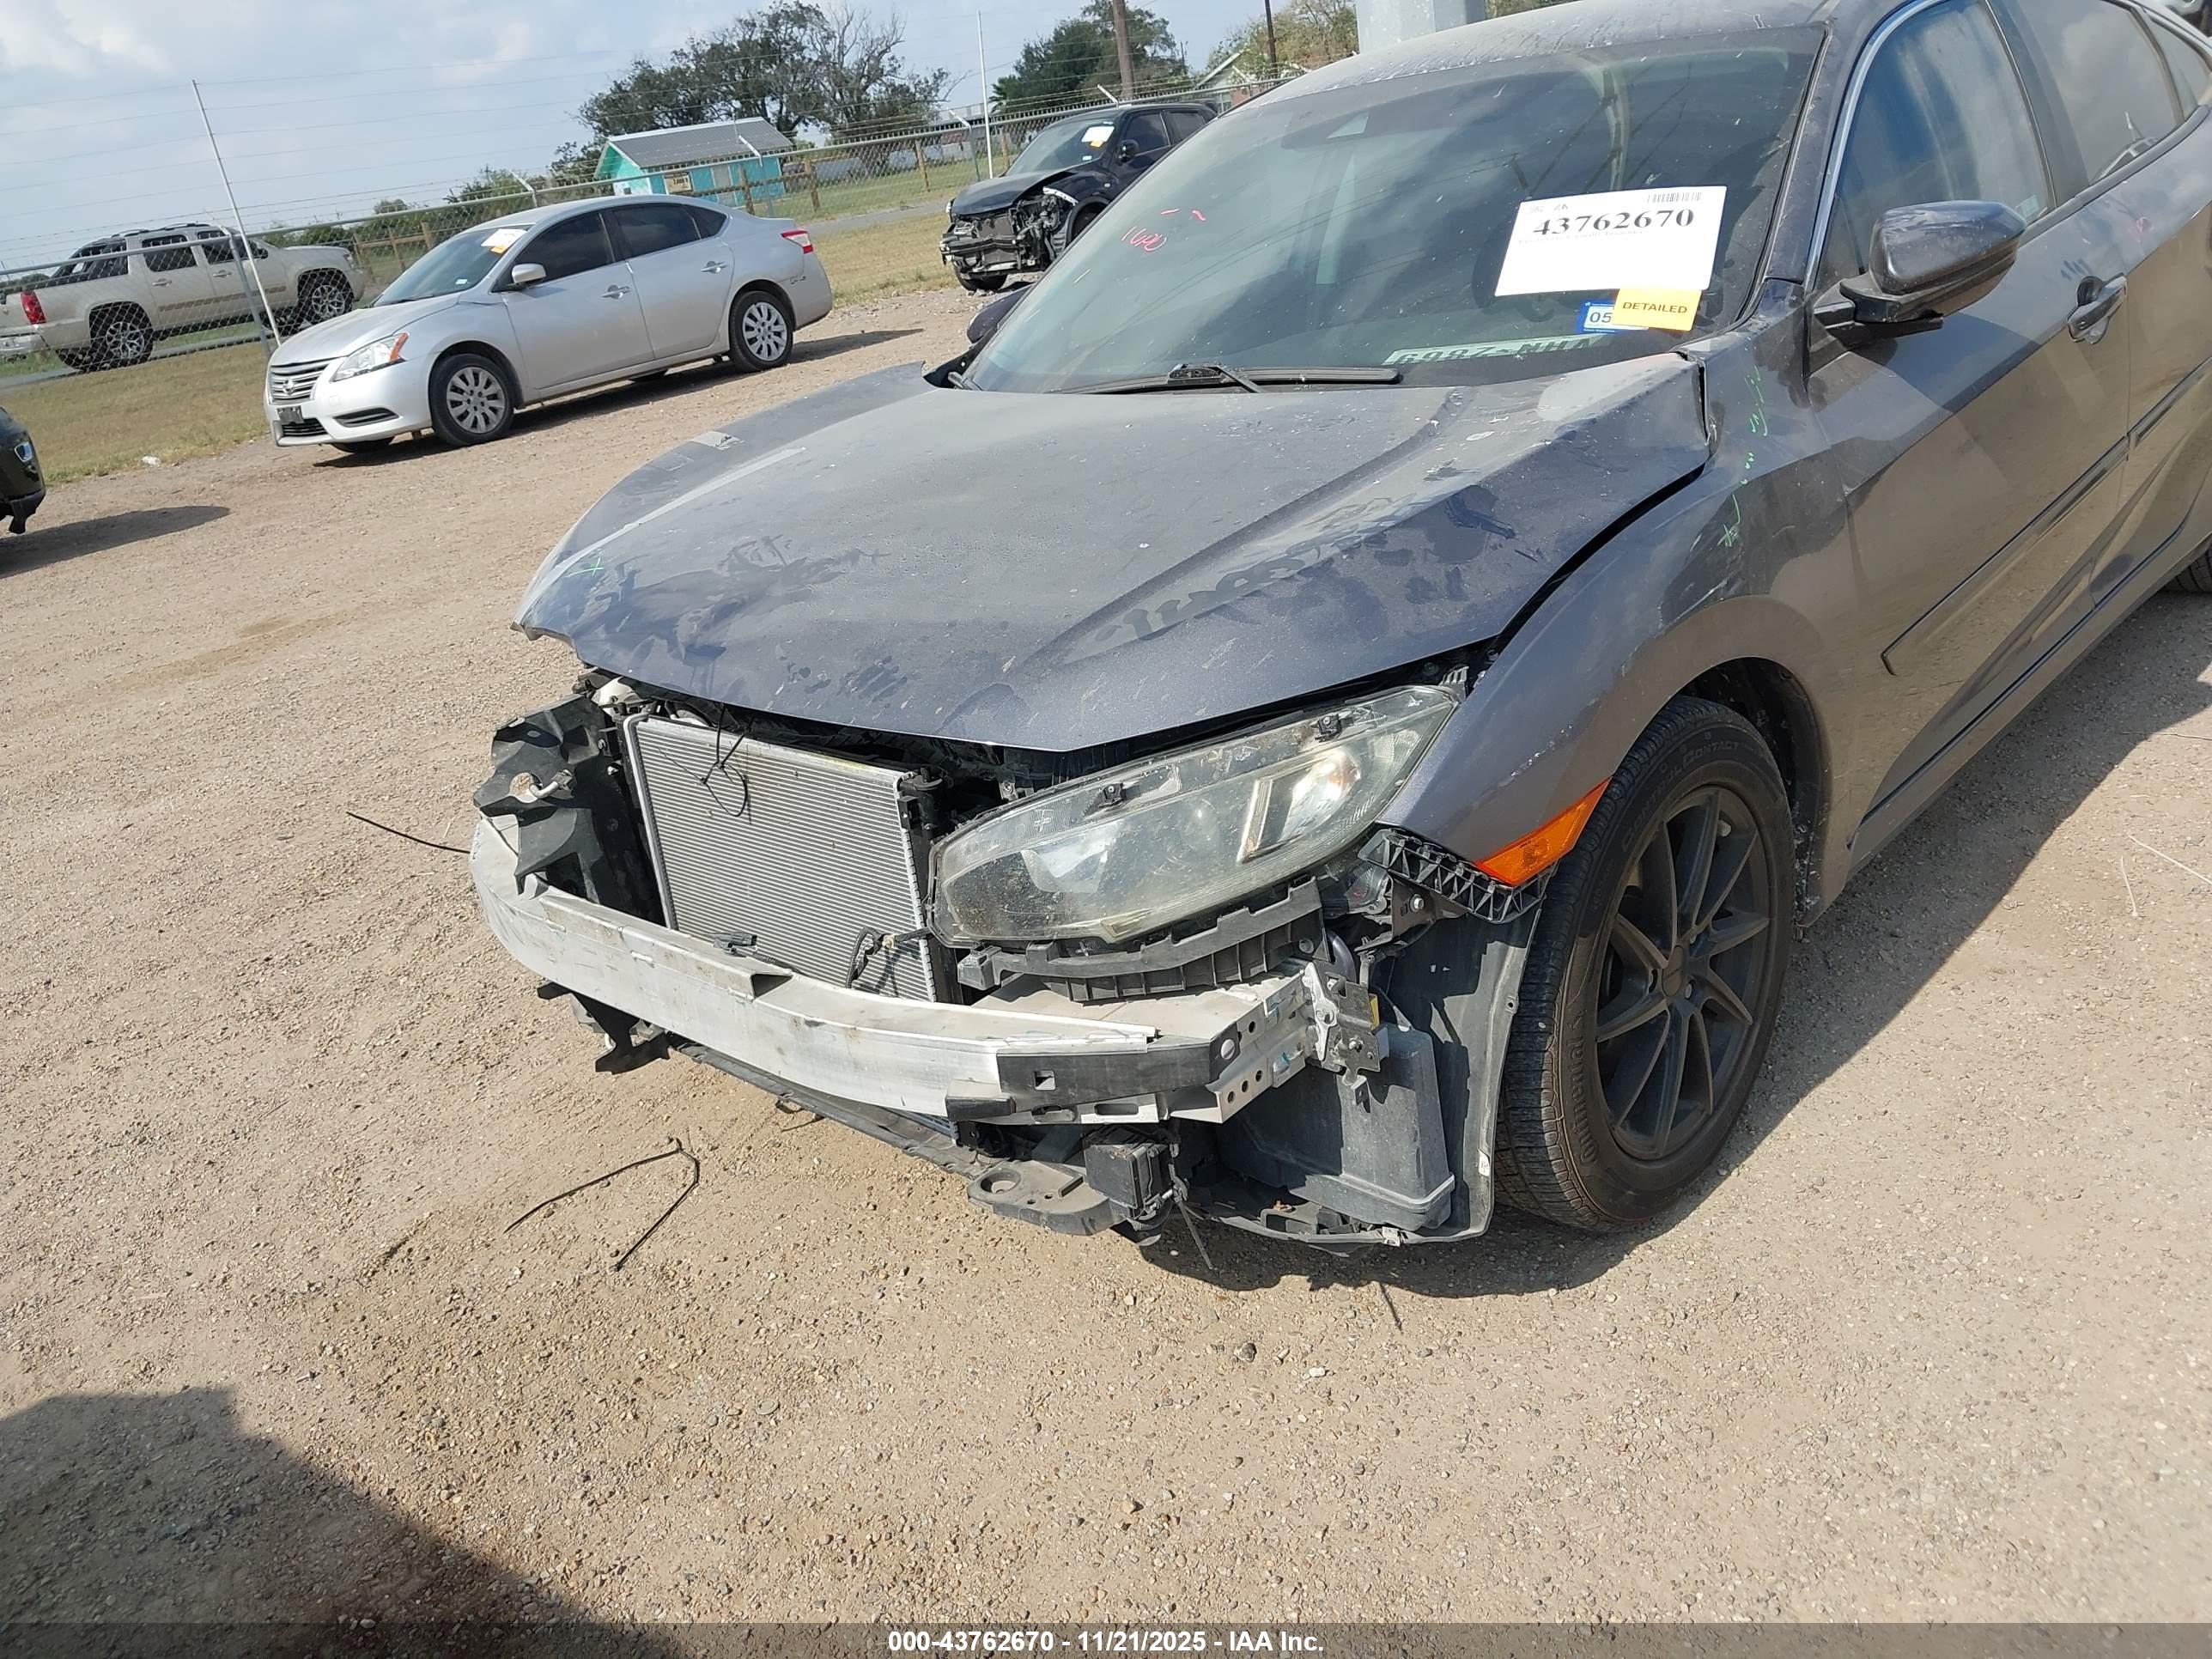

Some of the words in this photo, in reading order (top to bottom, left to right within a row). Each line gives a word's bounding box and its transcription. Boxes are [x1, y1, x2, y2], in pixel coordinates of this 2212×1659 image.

[1533, 208, 1695, 236] 43762670
[1622, 301, 1688, 314] DETAILED
[1589, 311, 1613, 324] 05
